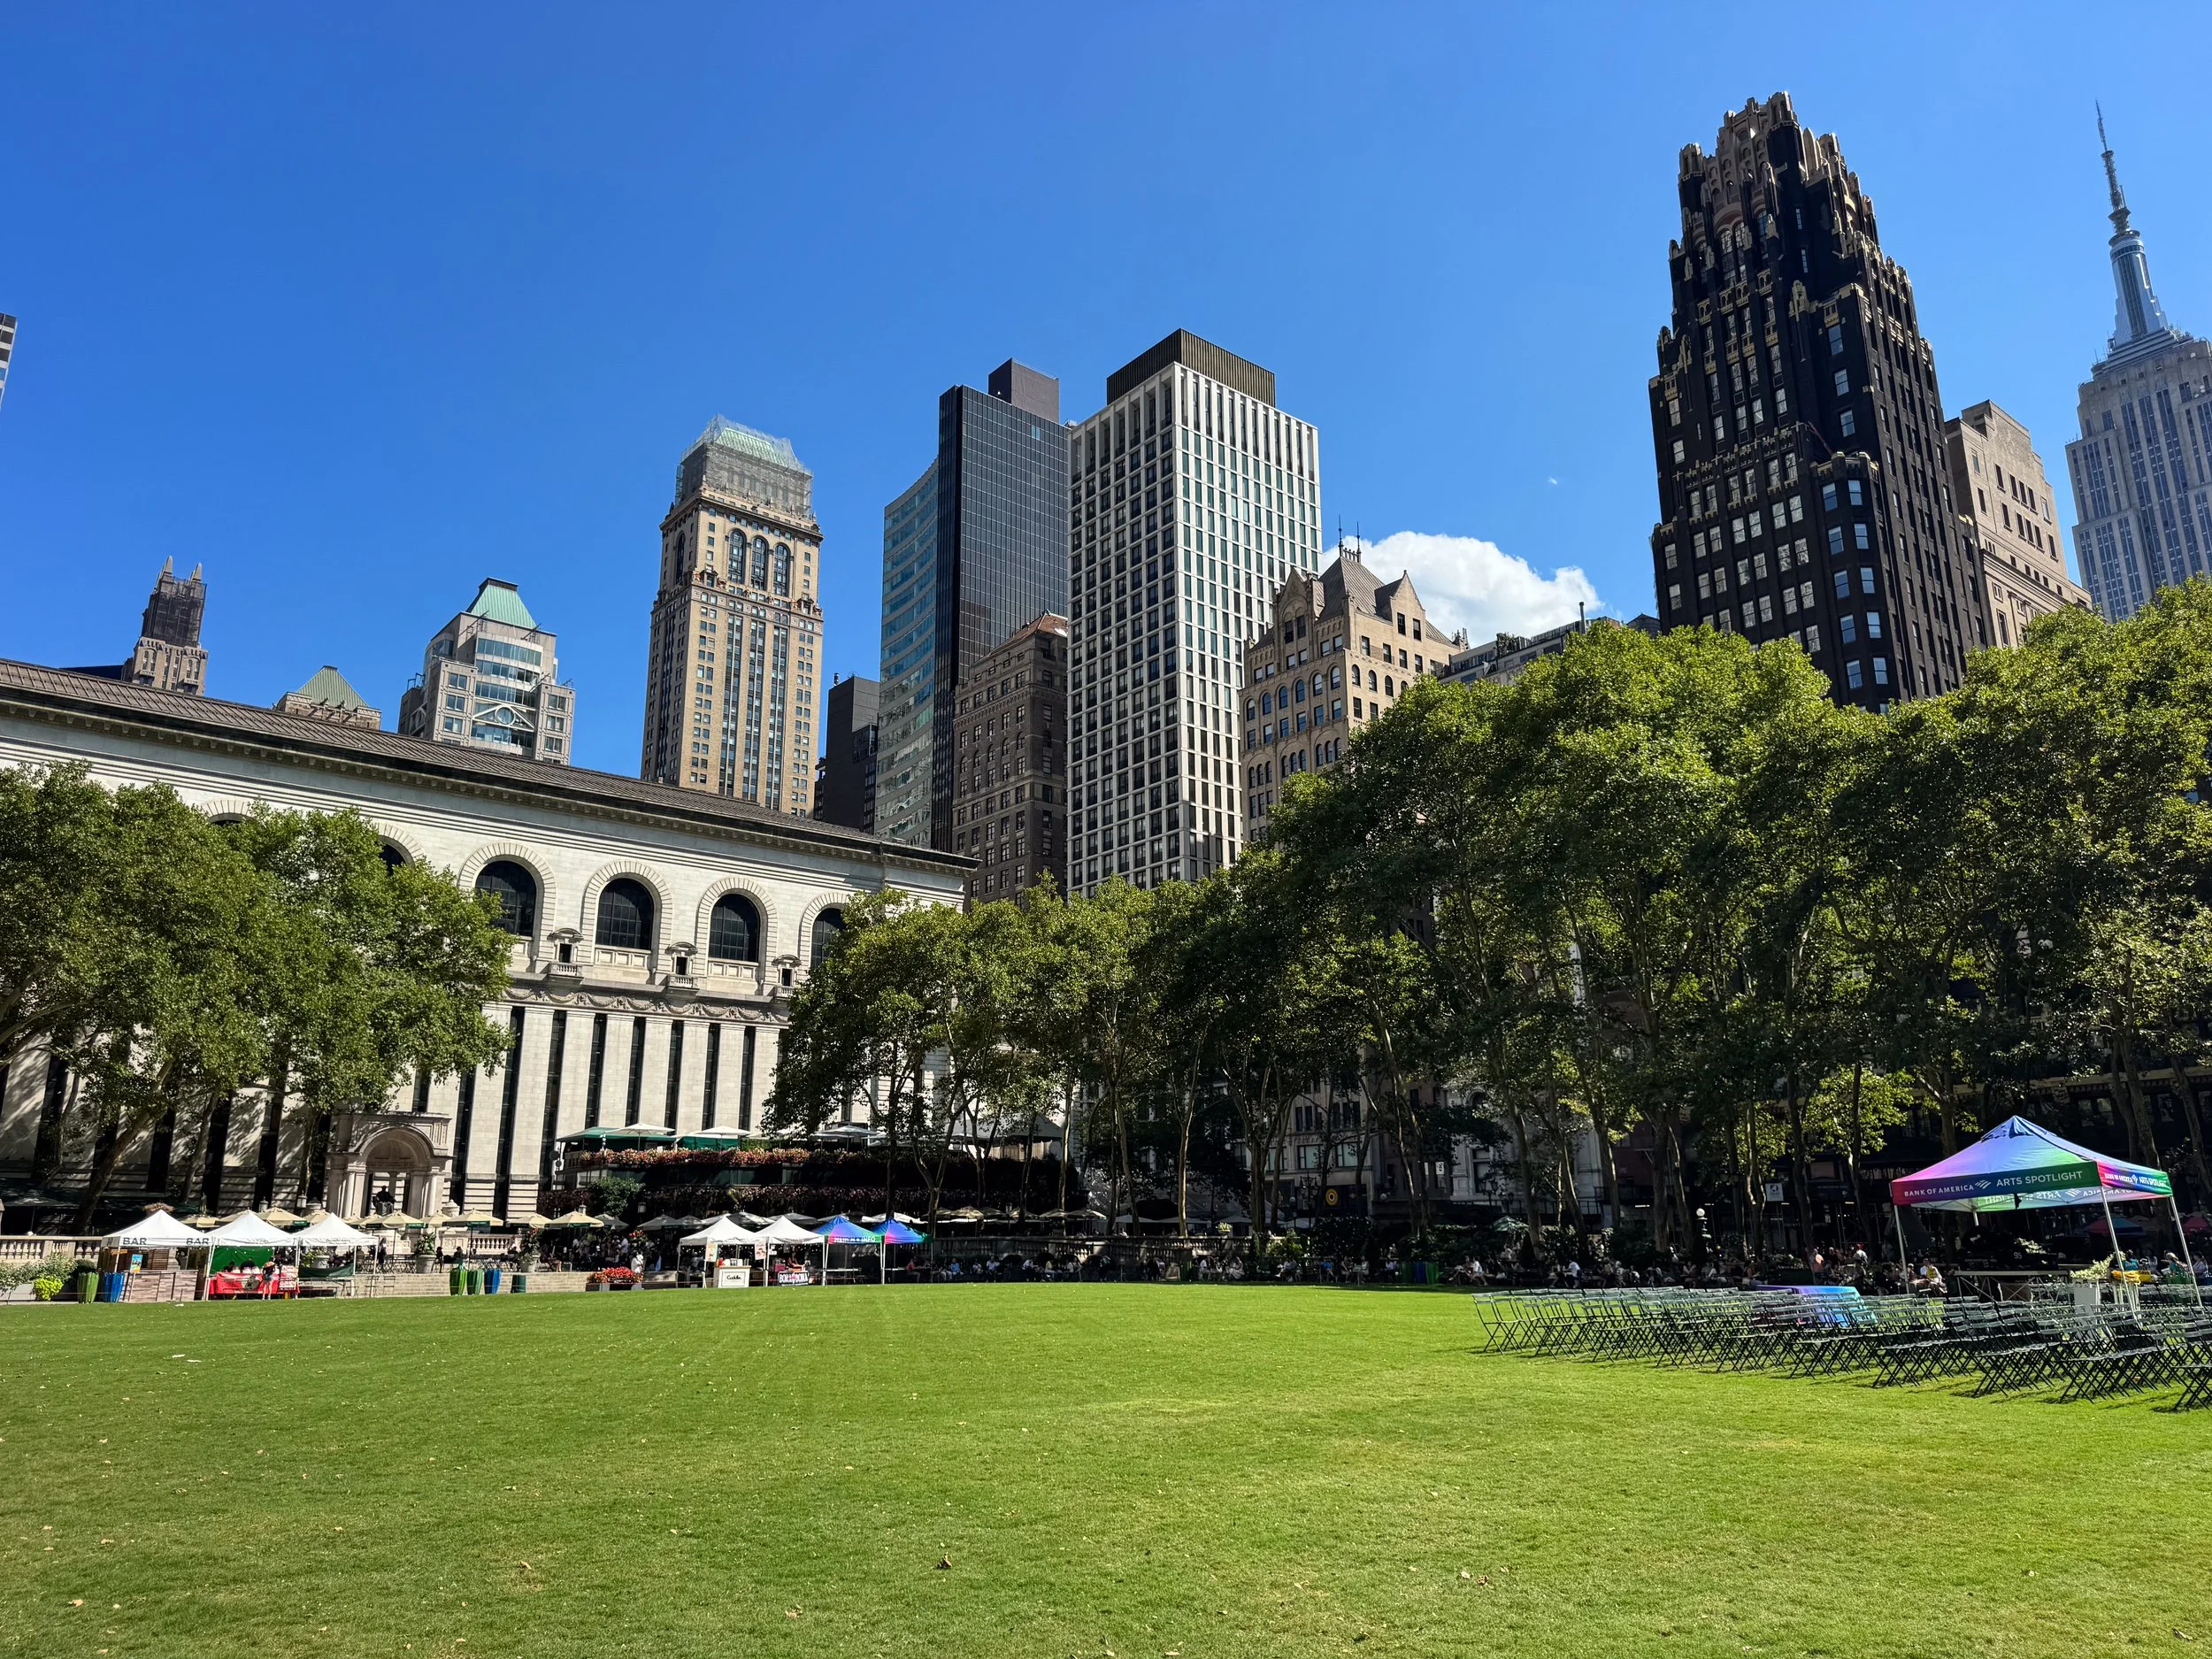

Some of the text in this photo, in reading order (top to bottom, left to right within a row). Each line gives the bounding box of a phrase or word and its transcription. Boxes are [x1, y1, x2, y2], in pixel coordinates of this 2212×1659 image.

[1939, 1184, 1974, 1194] AMERICA
[1996, 1177, 2023, 1187] ARTS
[2025, 1171, 2083, 1184] SPOTLIGHT
[186, 1237, 210, 1246] BAR
